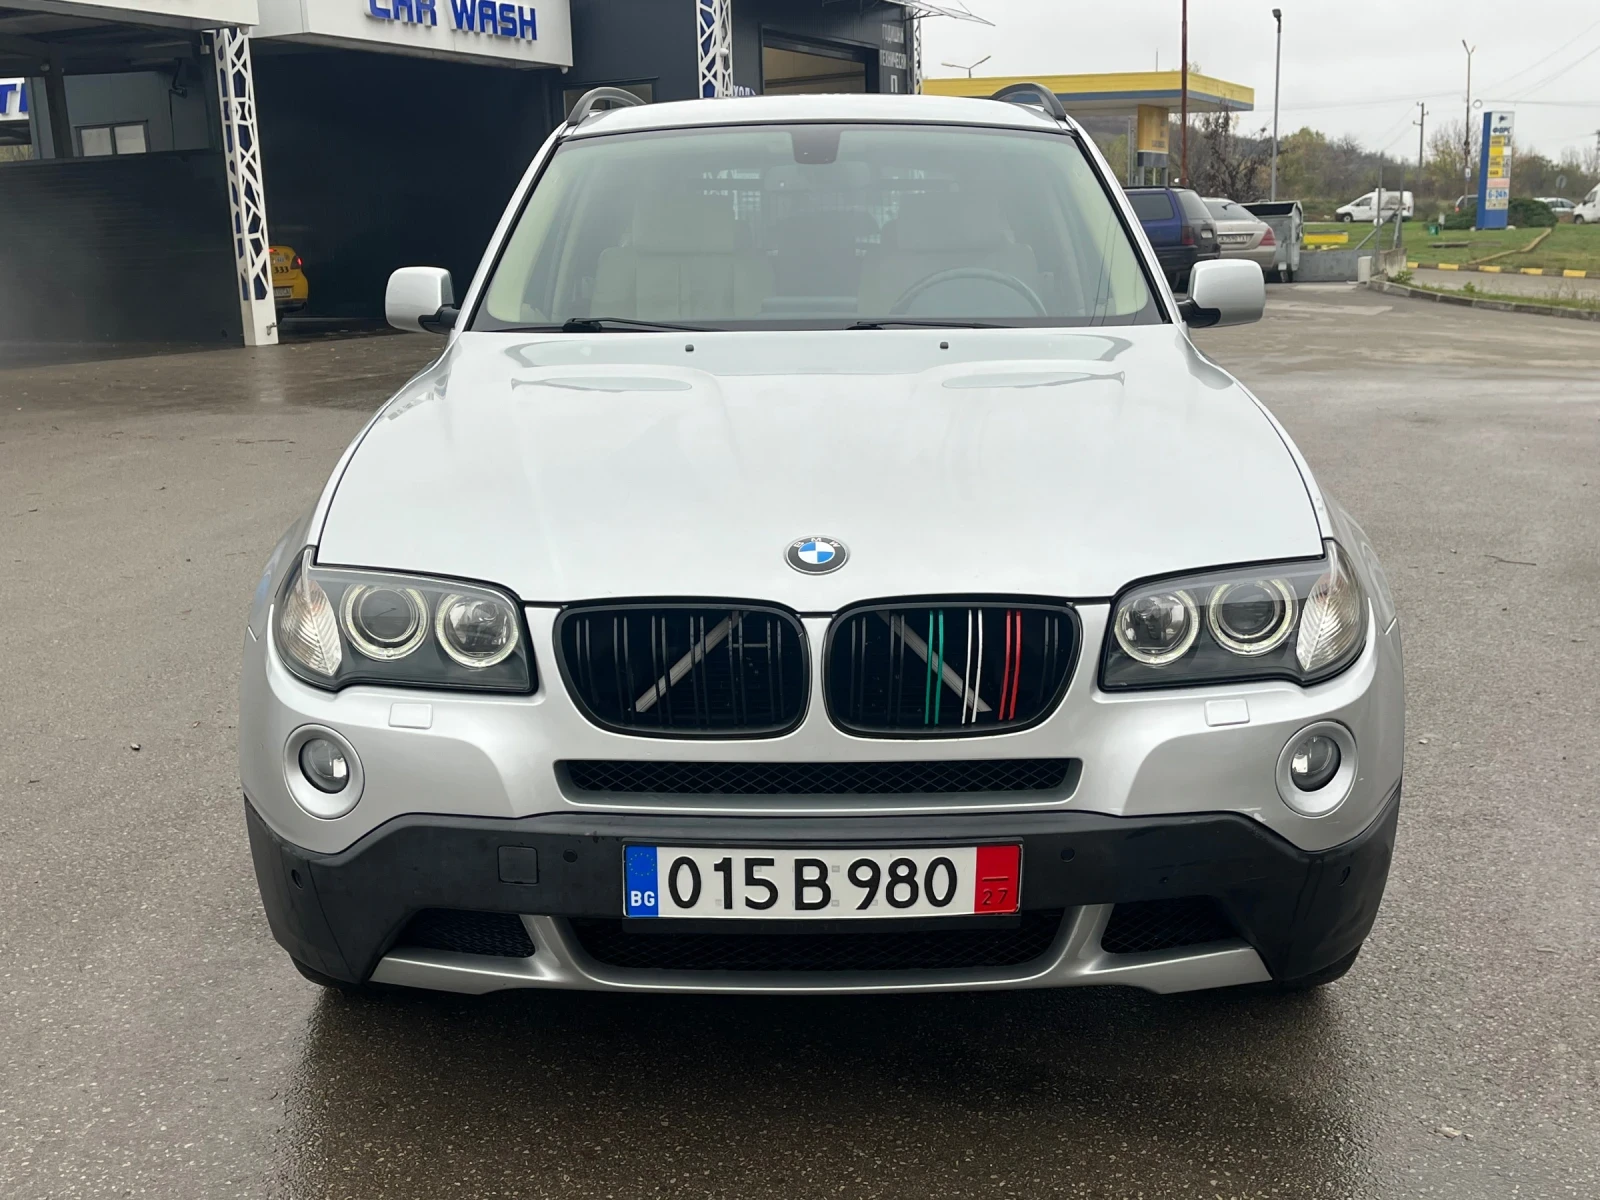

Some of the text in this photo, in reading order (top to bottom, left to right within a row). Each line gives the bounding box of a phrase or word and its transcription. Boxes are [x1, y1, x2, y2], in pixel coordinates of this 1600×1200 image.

[450, 0, 538, 41] WASH
[274, 265, 290, 274] 333
[793, 537, 841, 548] BMW
[630, 890, 656, 907] BG
[981, 888, 1009, 906] 27
